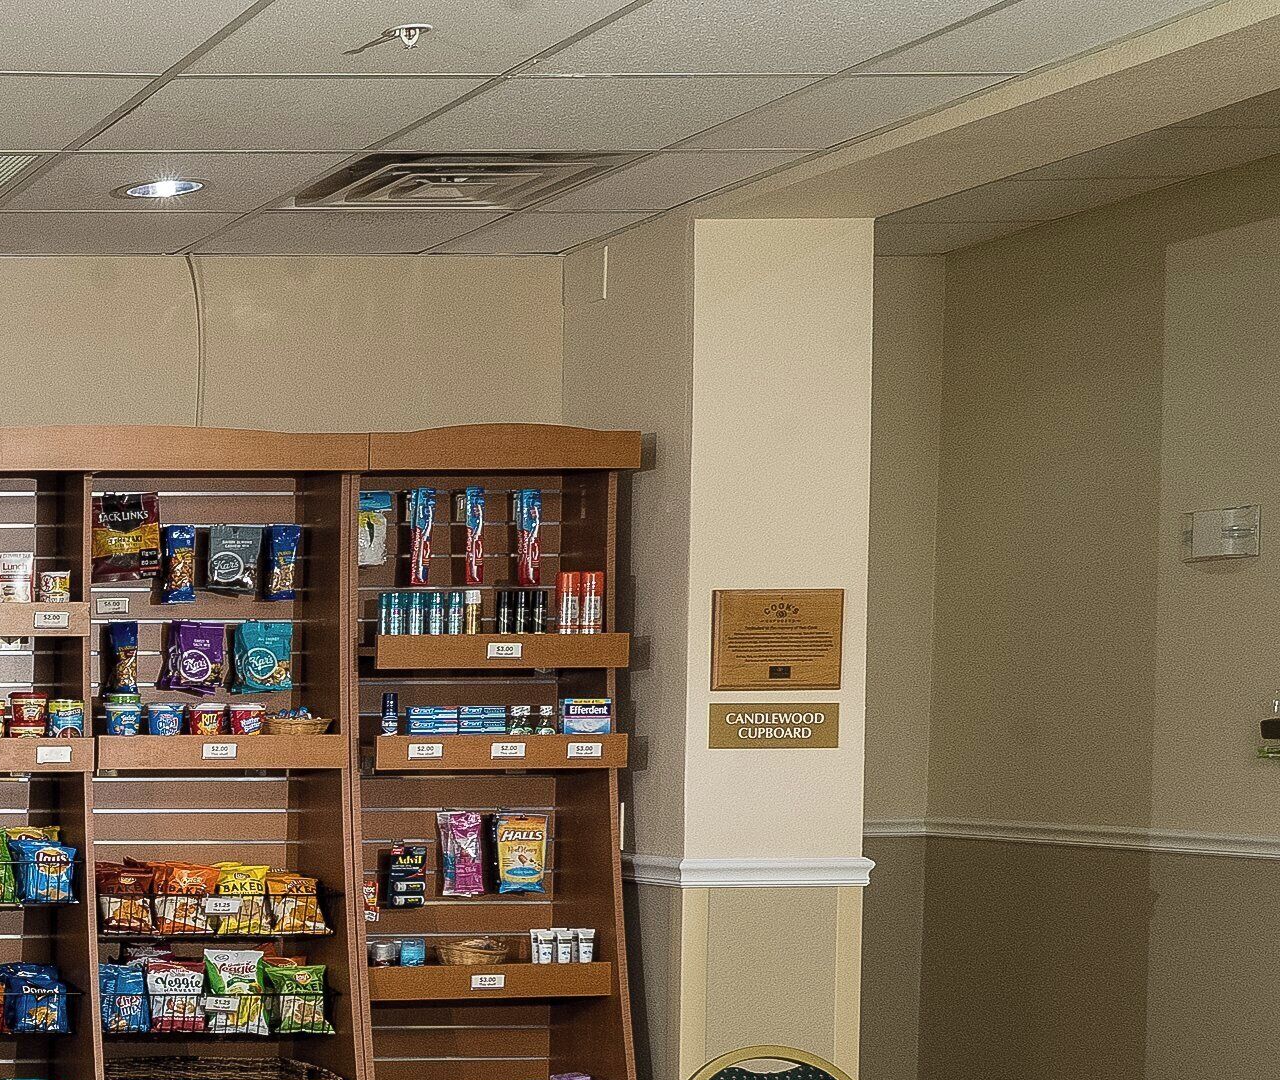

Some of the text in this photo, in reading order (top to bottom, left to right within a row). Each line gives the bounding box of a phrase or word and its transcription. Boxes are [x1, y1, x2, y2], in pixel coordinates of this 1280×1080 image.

[2, 562, 28, 571] Lunch
[569, 704, 608, 714] Efferdent
[725, 712, 825, 725] CANDLEWOOD
[738, 727, 812, 739] CUPBOARD
[500, 830, 543, 842] HALLS
[396, 855, 423, 865] Advil
[223, 880, 264, 893] BAKED
[154, 975, 202, 989] Veggie
